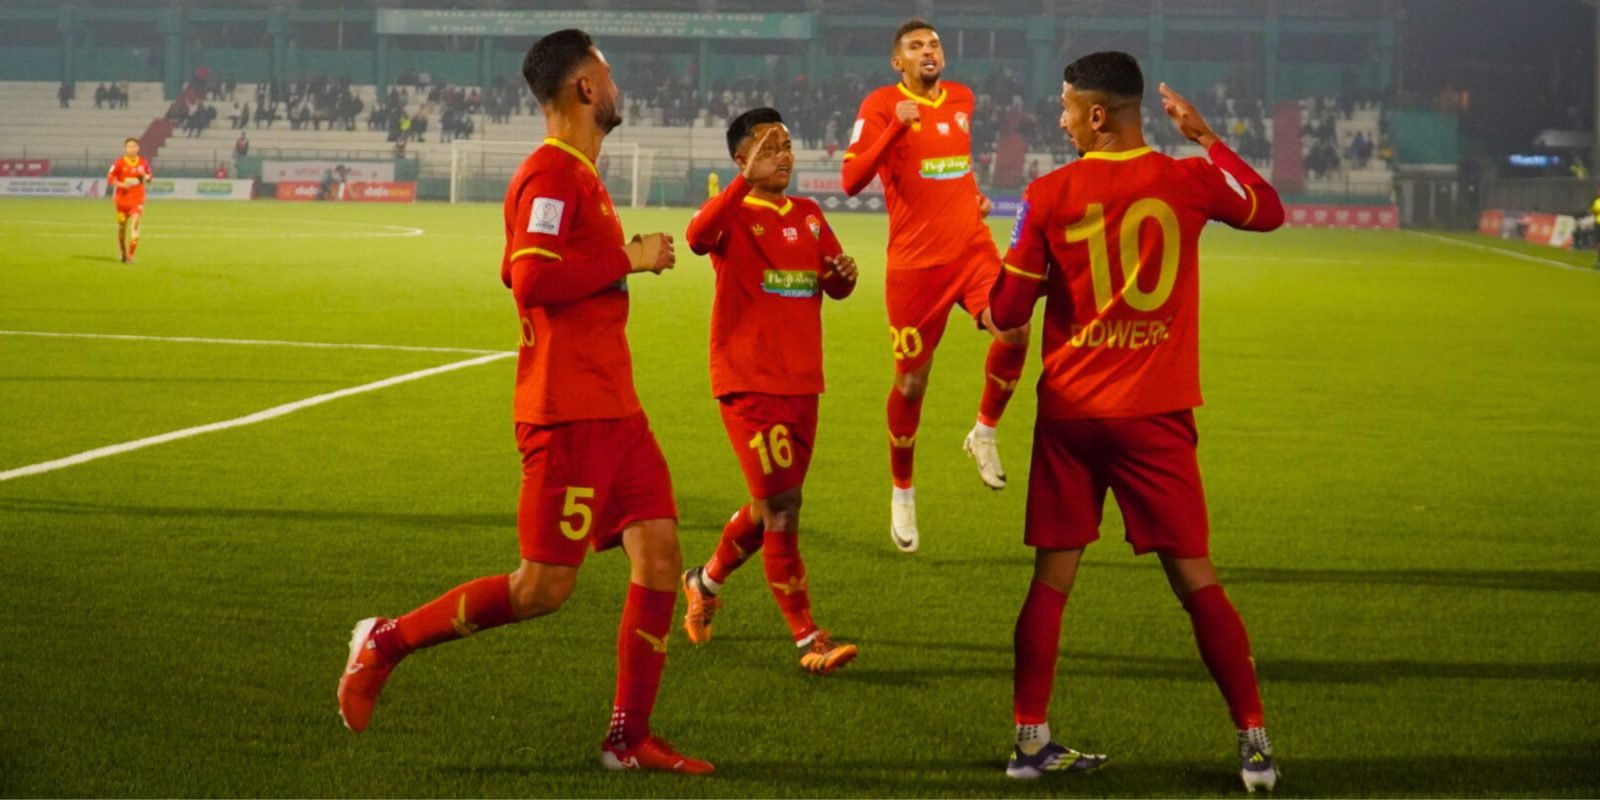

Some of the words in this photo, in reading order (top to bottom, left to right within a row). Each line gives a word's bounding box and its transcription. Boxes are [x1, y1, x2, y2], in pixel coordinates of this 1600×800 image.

[428, 24, 486, 33] STAND
[583, 25, 656, 34] FUNDED
[662, 26, 685, 35] BY
[534, 11, 614, 19] SPORTS
[622, 12, 765, 21] ASSOCIATION
[1065, 197, 1181, 313] 10
[889, 326, 923, 360] 20
[749, 424, 793, 475] 16
[559, 486, 595, 541] 5
